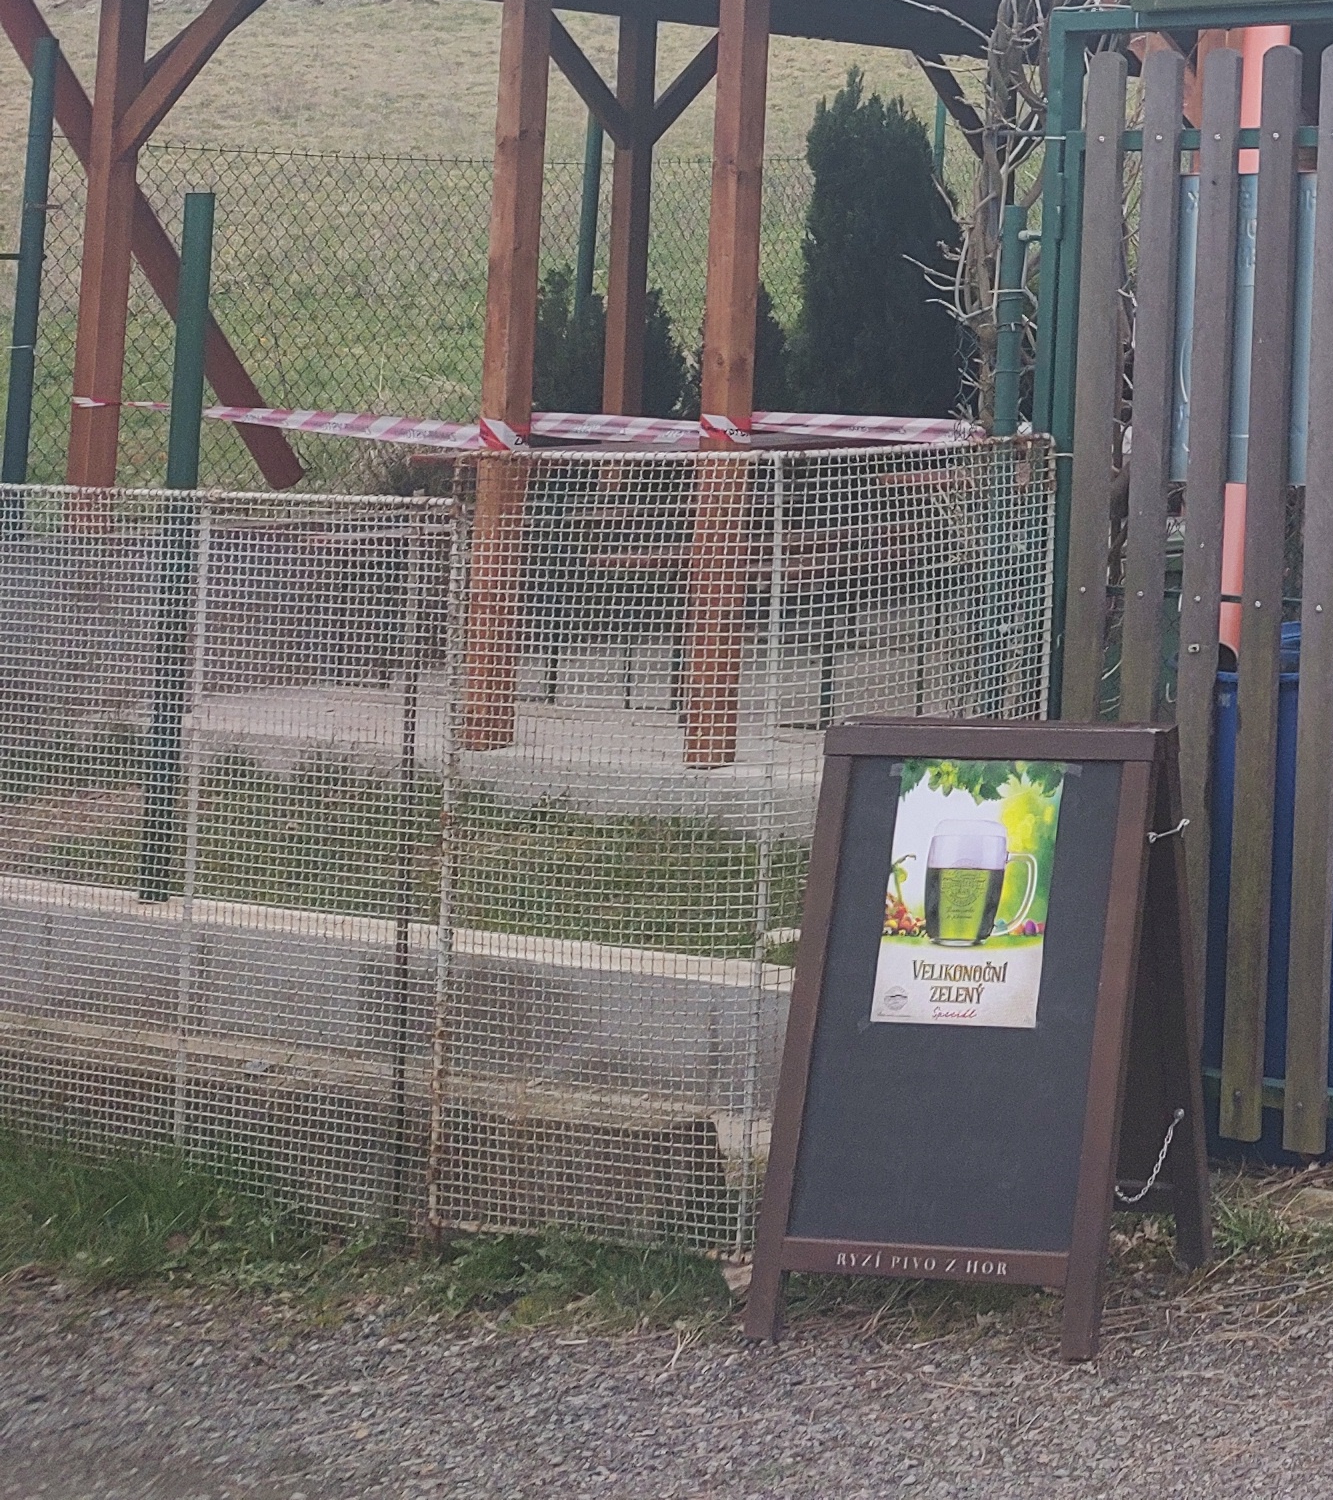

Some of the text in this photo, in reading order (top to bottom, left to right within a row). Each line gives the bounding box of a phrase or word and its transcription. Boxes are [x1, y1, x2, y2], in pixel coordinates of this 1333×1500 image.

[912, 960, 1008, 984] VELIKONOČNÍ
[930, 983, 984, 1005] ZELENÝ
[836, 1250, 1008, 1276] RYZÍ PIVO Z HOR
